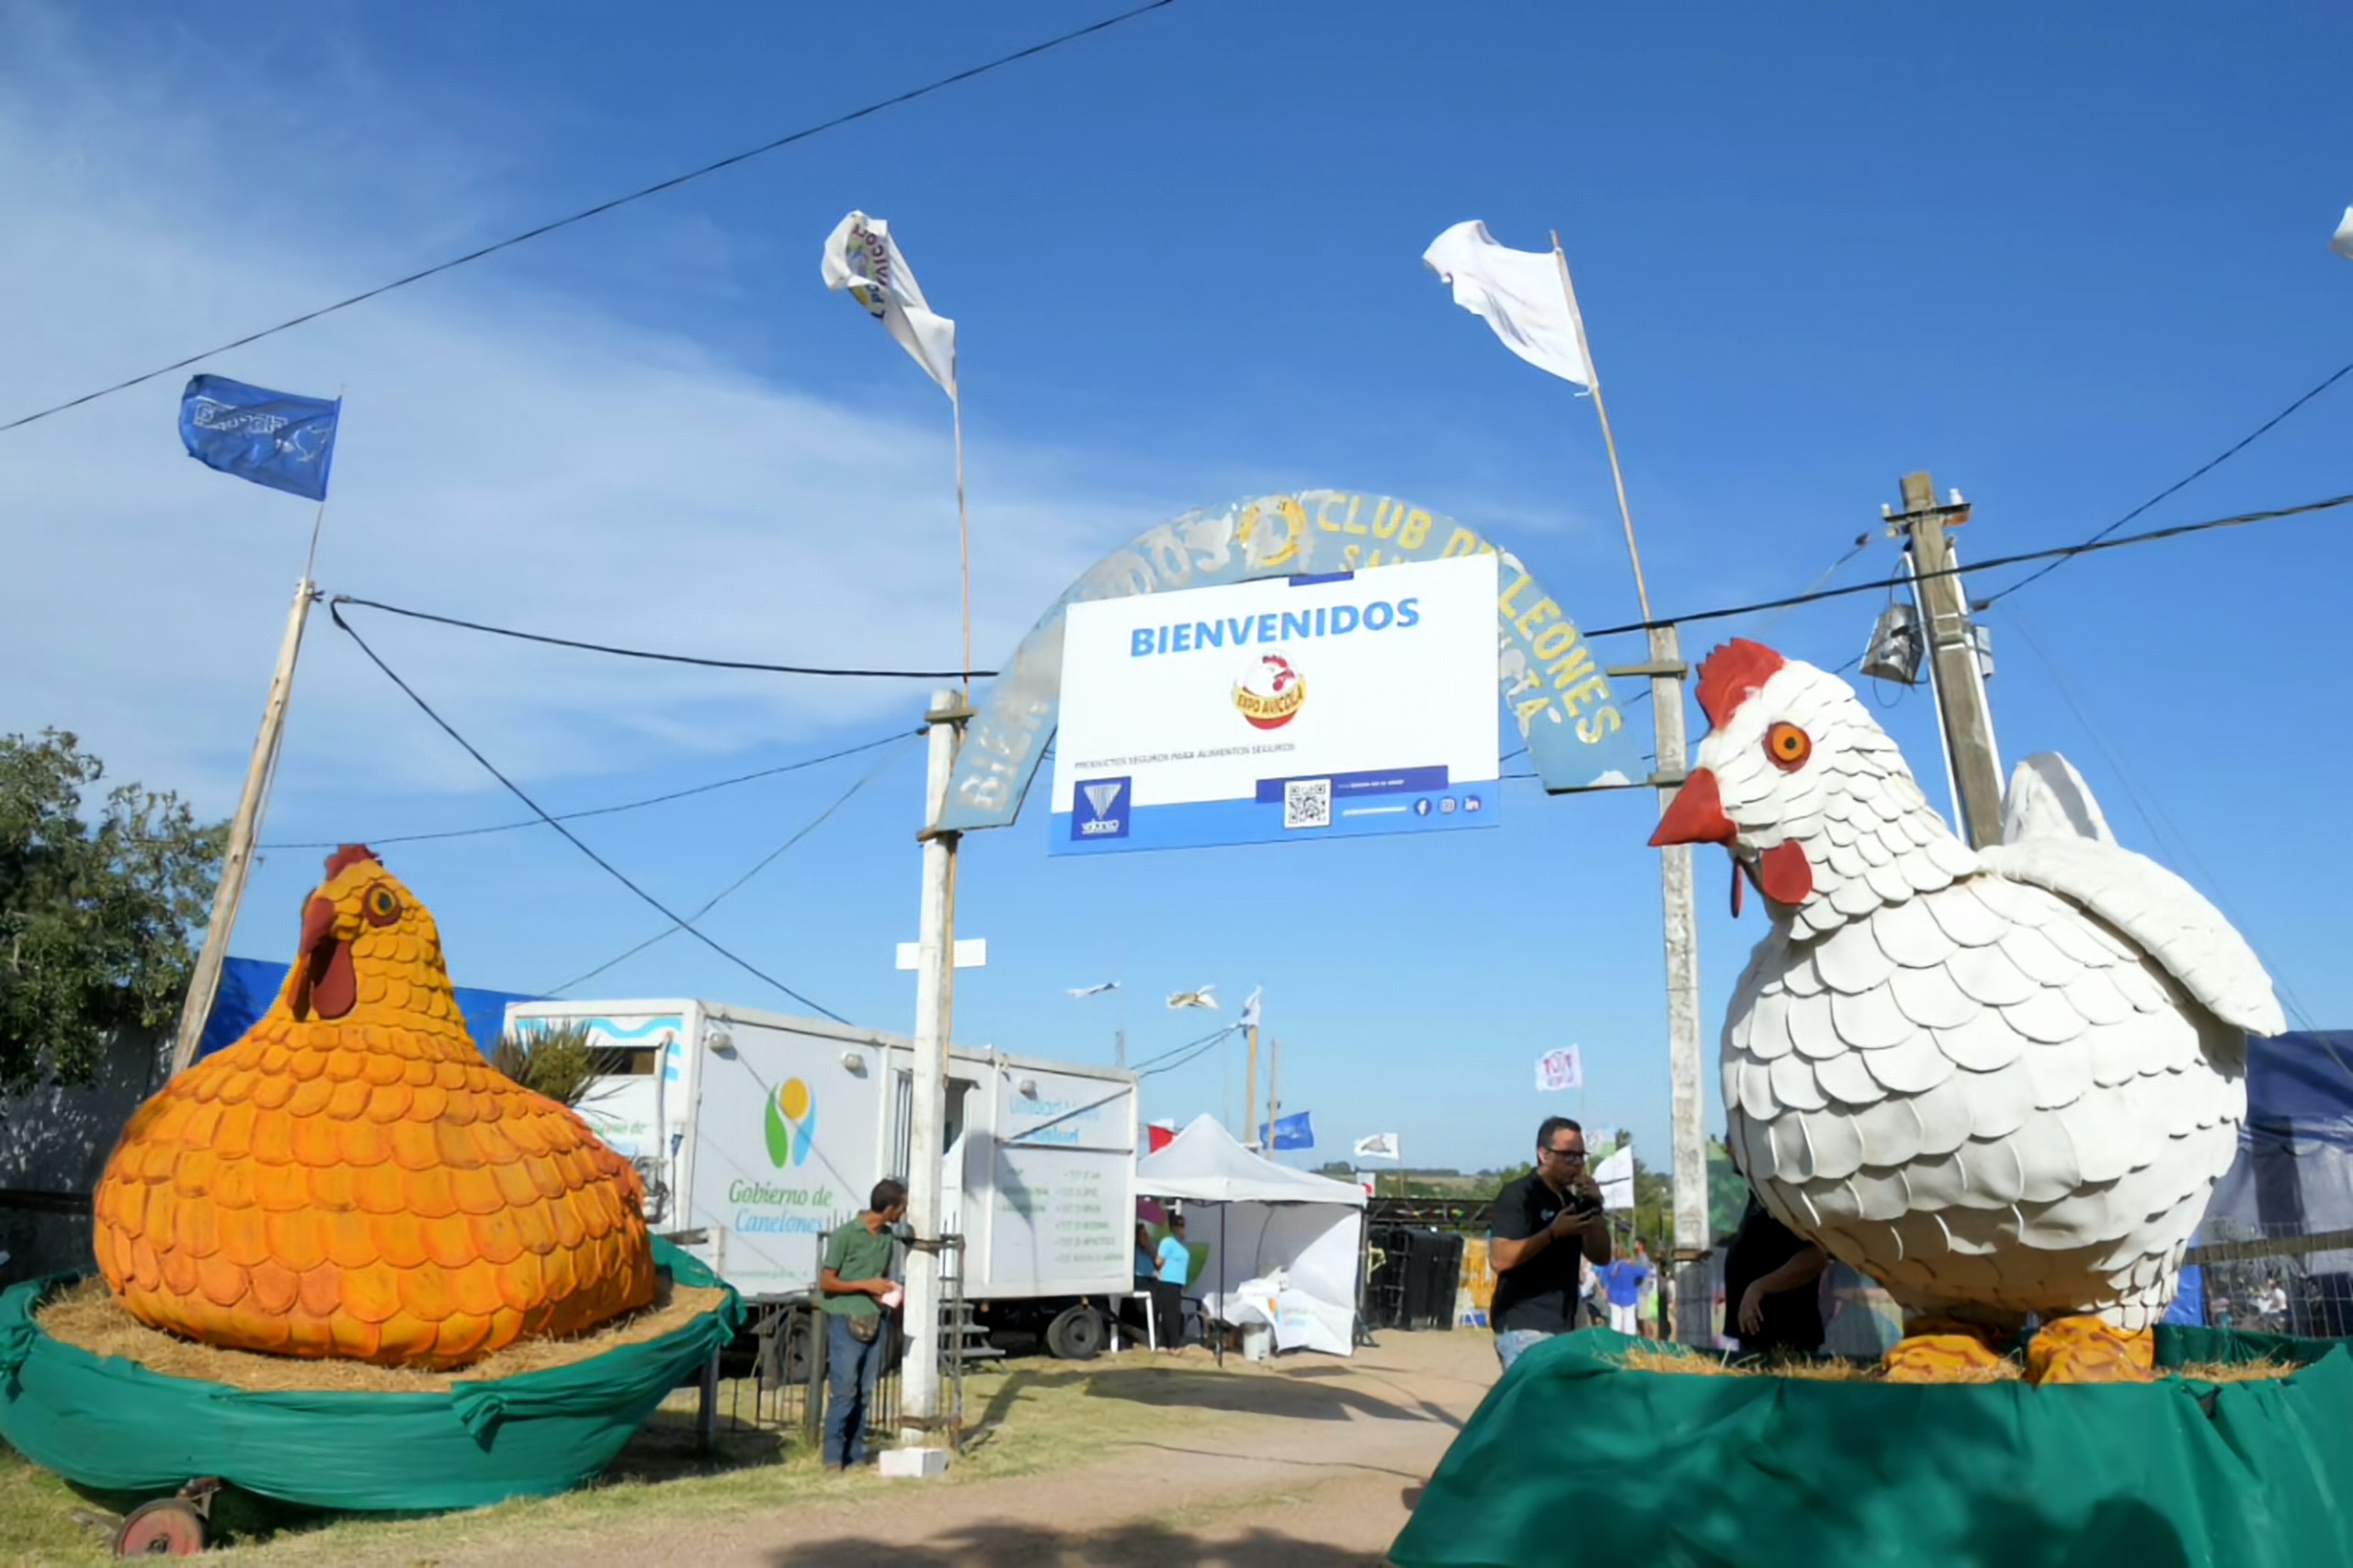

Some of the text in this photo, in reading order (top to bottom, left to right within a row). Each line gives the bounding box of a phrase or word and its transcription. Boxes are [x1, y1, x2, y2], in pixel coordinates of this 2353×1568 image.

[1131, 597, 1420, 657] BIENVENIDOS
[1317, 490, 1434, 551] CLUB
[1498, 574, 1621, 744] LEONES
[1237, 694, 1261, 713] EXPO
[729, 1178, 834, 1207] Gobierno de
[735, 1208, 824, 1233] Canelones
